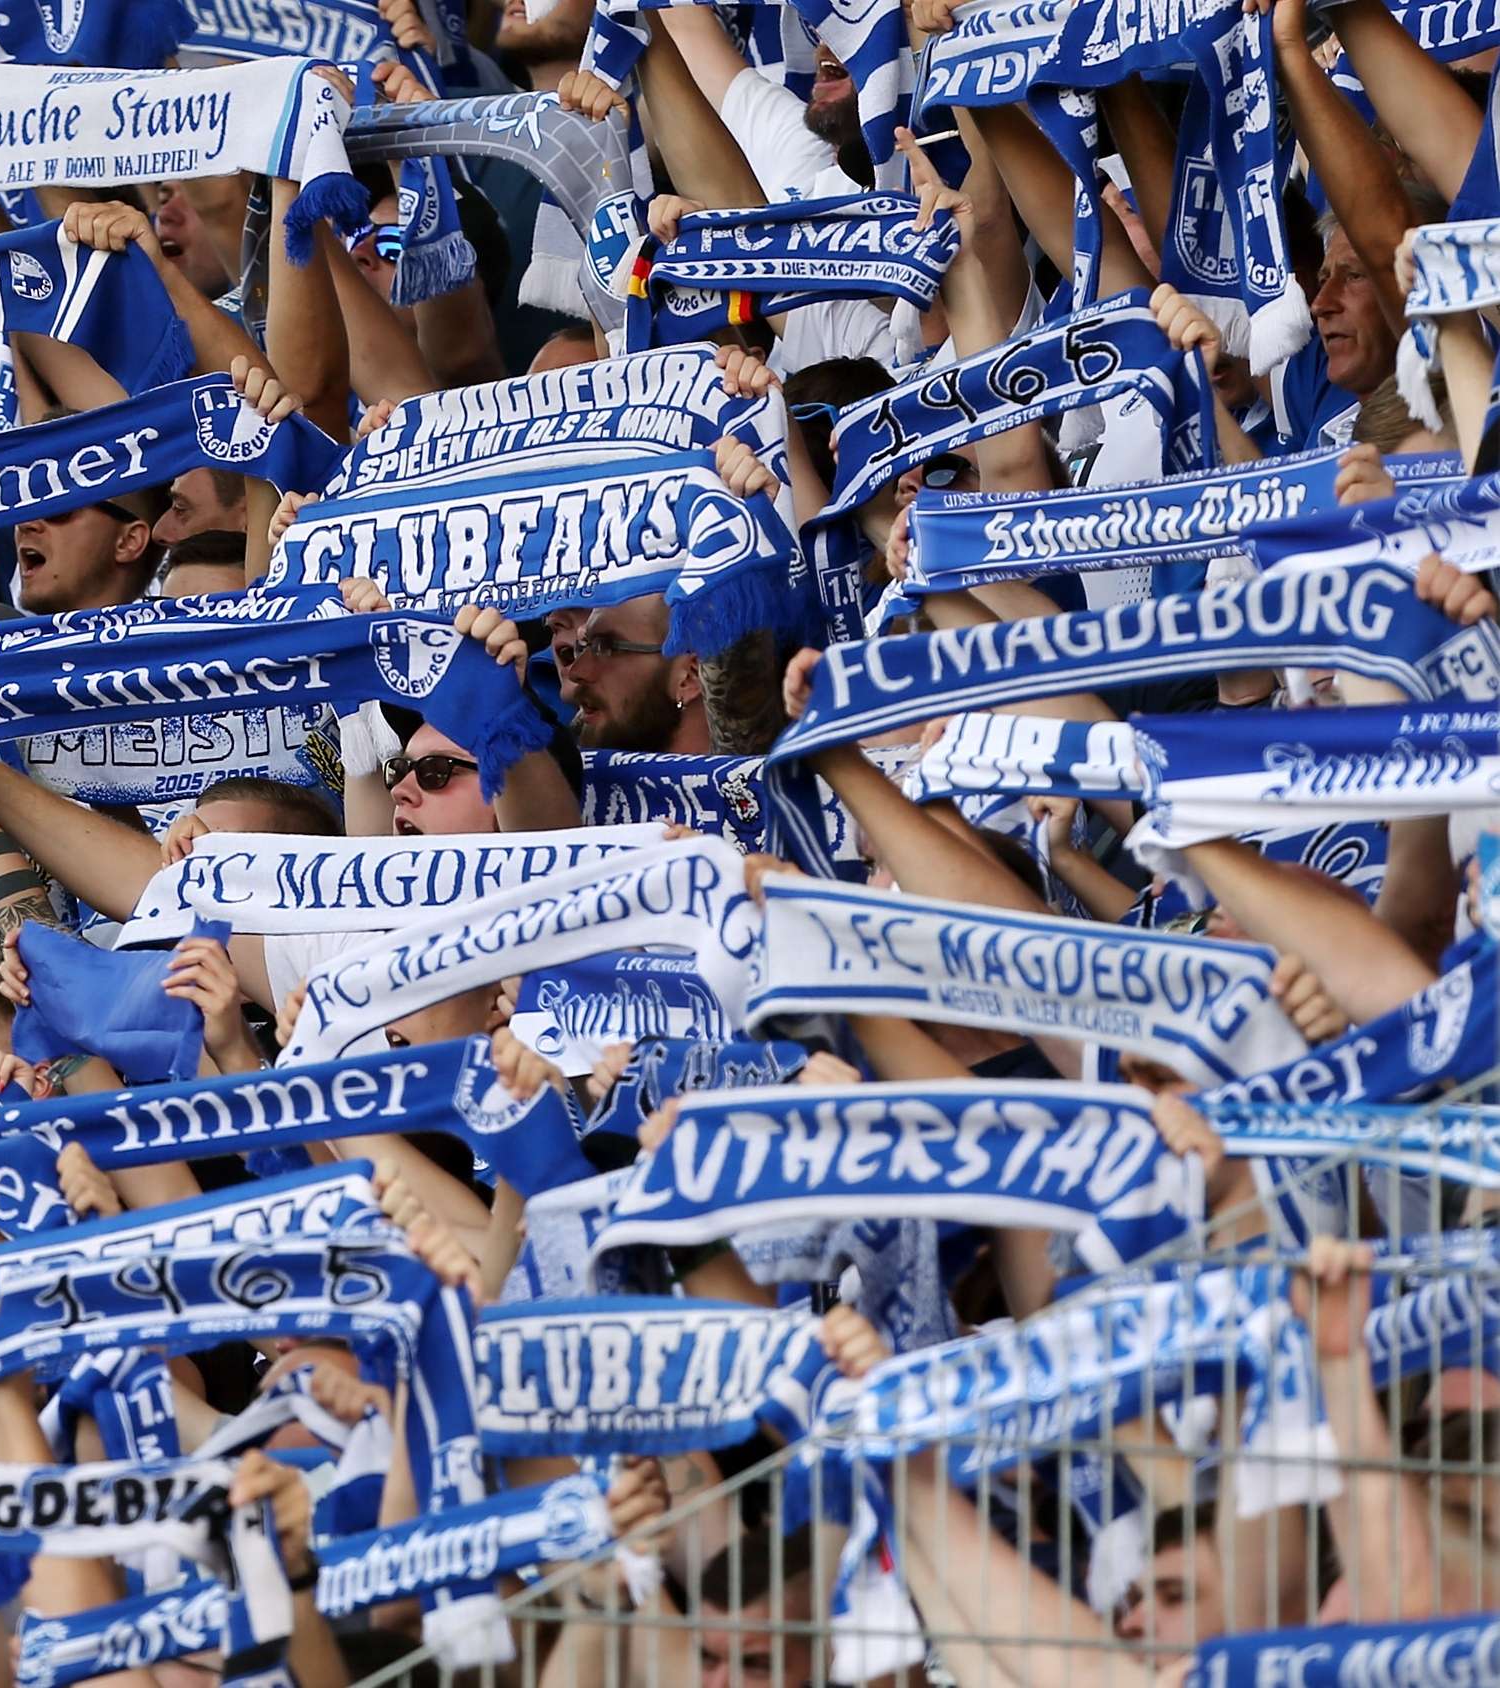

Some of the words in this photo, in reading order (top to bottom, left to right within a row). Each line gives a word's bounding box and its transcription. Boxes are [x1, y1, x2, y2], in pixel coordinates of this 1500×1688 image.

[105, 87, 232, 160] Stawy
[43, 158, 59, 180] W
[65, 156, 106, 179] DOMU
[114, 149, 199, 177] NAJLEPIEJ!
[700, 223, 776, 254] FC
[781, 262, 807, 276] DIE
[809, 262, 871, 278] MACHT
[414, 350, 735, 442] MAGDEBURG
[867, 316, 1125, 467] 1965
[356, 435, 468, 488] SPIELEN
[471, 422, 523, 461] MIT
[526, 413, 579, 450] ALS
[580, 410, 612, 441] 12.
[868, 464, 894, 492] SIND
[907, 445, 934, 466] WIR
[947, 432, 969, 451] DIE
[1058, 391, 1083, 411] AUF
[302, 473, 690, 596] CLUBFANS
[375, 624, 456, 650] 1.FC
[376, 645, 449, 697] MAGDEBURG
[825, 640, 915, 708] FC
[926, 562, 1416, 686] MAGDEBURG
[56, 650, 338, 713] immer
[176, 851, 257, 909] FC
[304, 957, 372, 1036] FC
[937, 923, 1273, 1044] MAGDEBURG
[937, 982, 1006, 1020] MEISTER
[1012, 994, 1062, 1027] ALLER
[1066, 1000, 1143, 1038] KLASSEN
[105, 1060, 429, 1152] immer
[1203, 1036, 1379, 1104] mer
[28, 1242, 393, 1332] 1965
